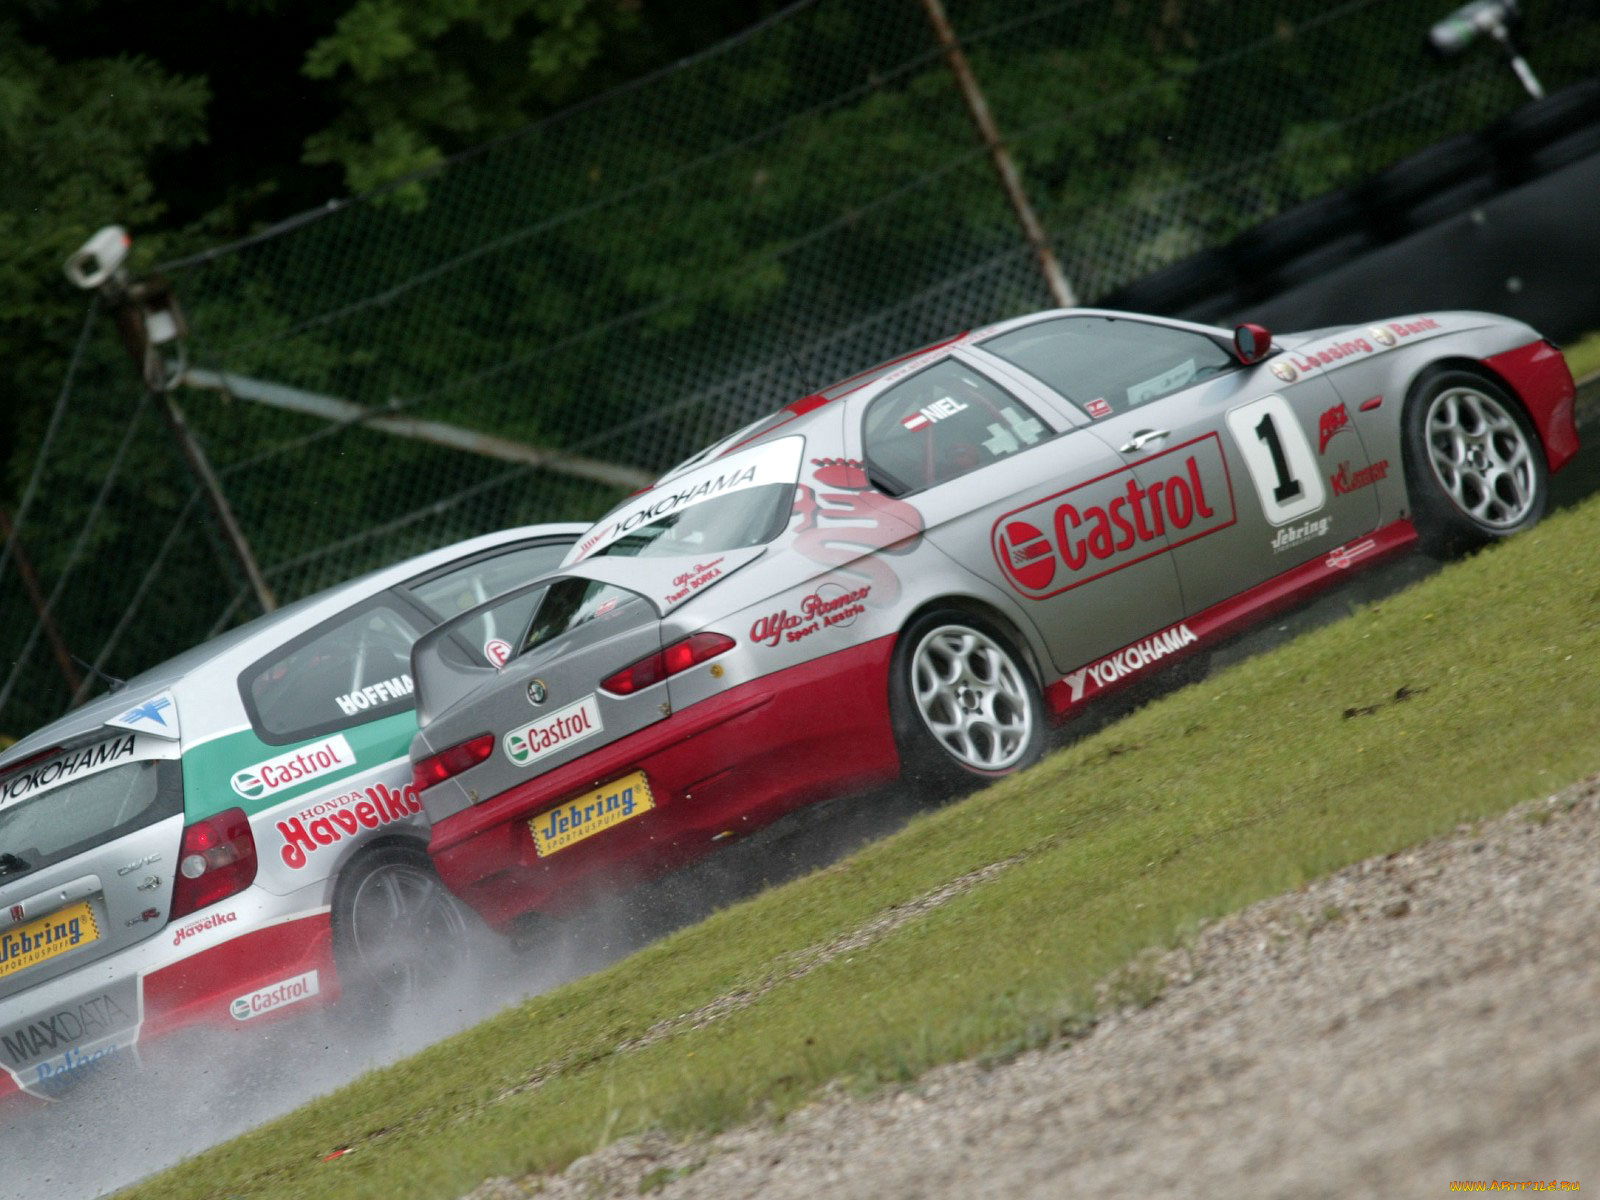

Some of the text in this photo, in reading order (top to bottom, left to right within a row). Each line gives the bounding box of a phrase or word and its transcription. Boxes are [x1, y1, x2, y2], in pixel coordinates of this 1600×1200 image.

[1290, 316, 1441, 372] Leasing Bank
[1254, 412, 1300, 502] 1
[611, 465, 756, 538] YOKOHAMA
[1054, 456, 1214, 571] Castrol
[664, 587, 690, 604] Team
[749, 585, 871, 647] Alfa Romeo
[786, 604, 865, 643] Sport Austria
[1088, 624, 1198, 687] YOKOHAMA
[527, 706, 591, 753] Castrol
[0, 735, 136, 804] YOKOHAMA
[260, 744, 341, 788] Castrol
[276, 783, 421, 869] Havelka
[300, 791, 363, 820] HONDA
[542, 787, 637, 840] Sebring
[173, 912, 237, 946] Havelka
[251, 977, 309, 1012] Castrol
[1, 994, 130, 1063] MAXDATA
